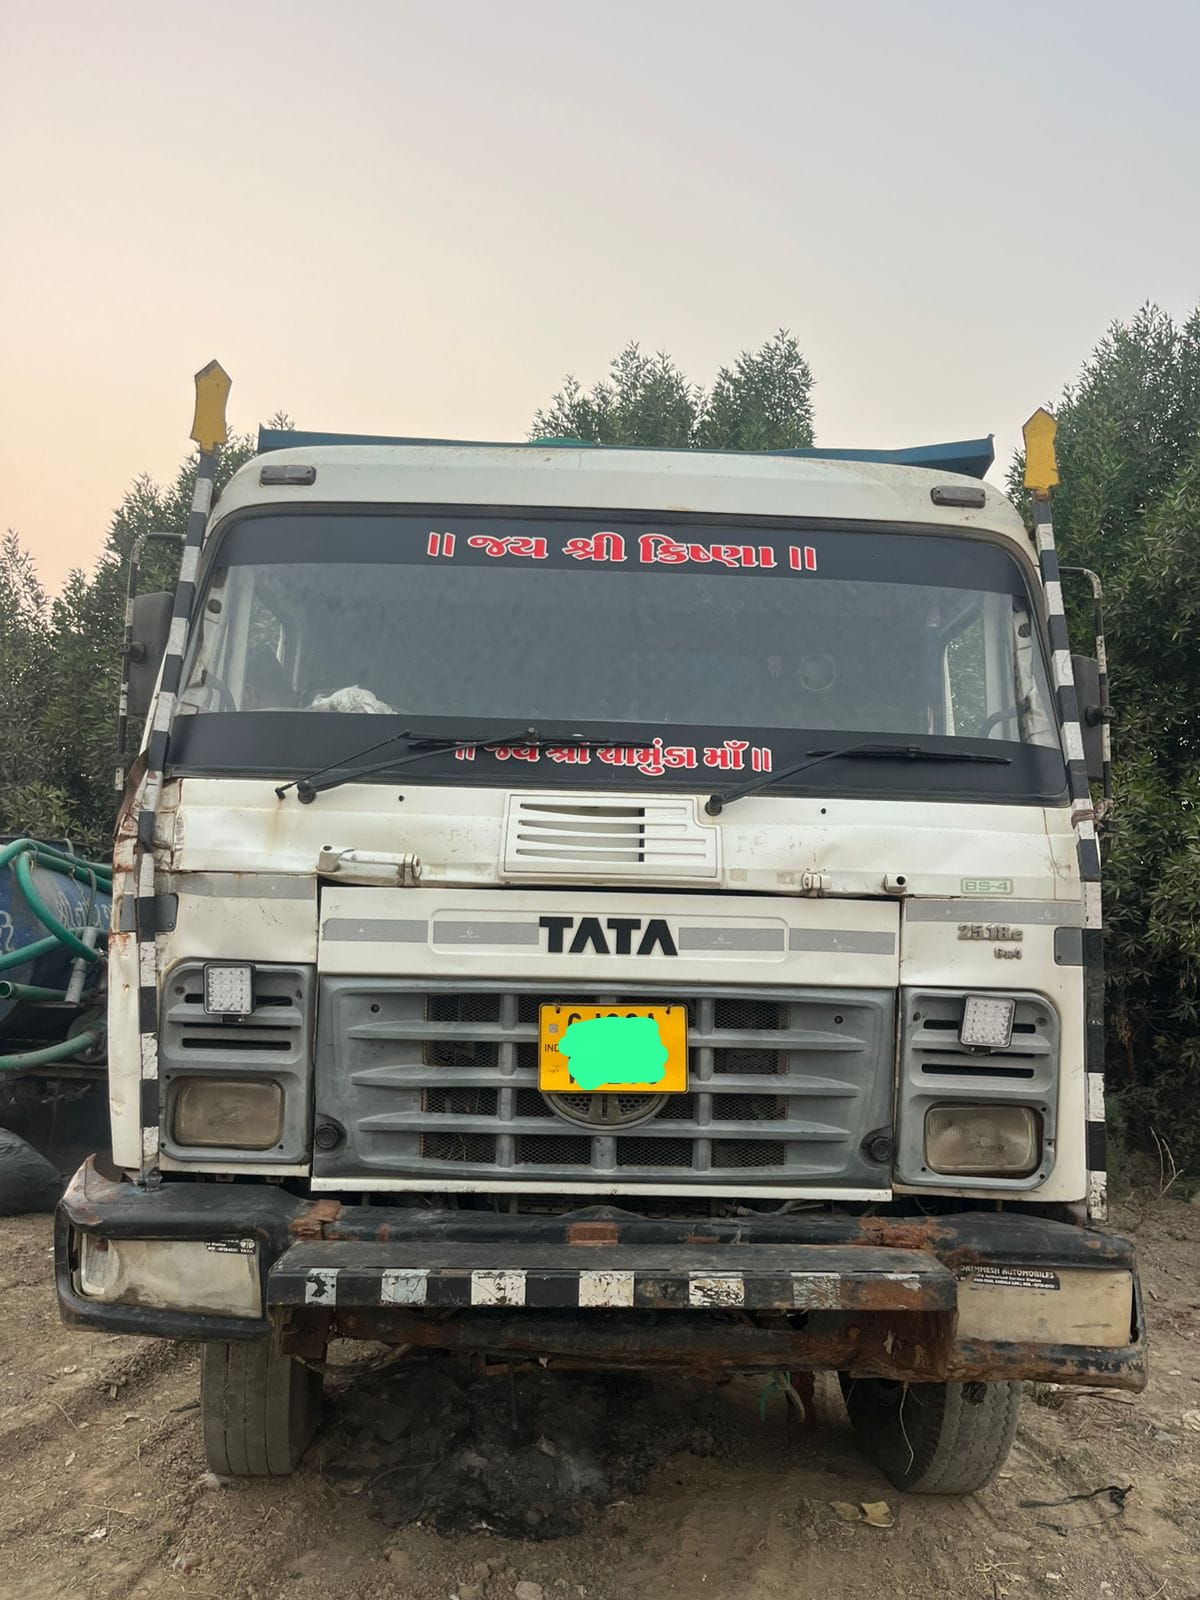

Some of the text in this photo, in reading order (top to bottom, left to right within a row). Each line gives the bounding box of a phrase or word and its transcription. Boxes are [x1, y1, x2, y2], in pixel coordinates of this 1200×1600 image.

[467, 534, 549, 560] જય
[562, 531, 628, 563] શ્રી
[965, 881, 1009, 891] BS-4
[539, 916, 678, 956] TATA
